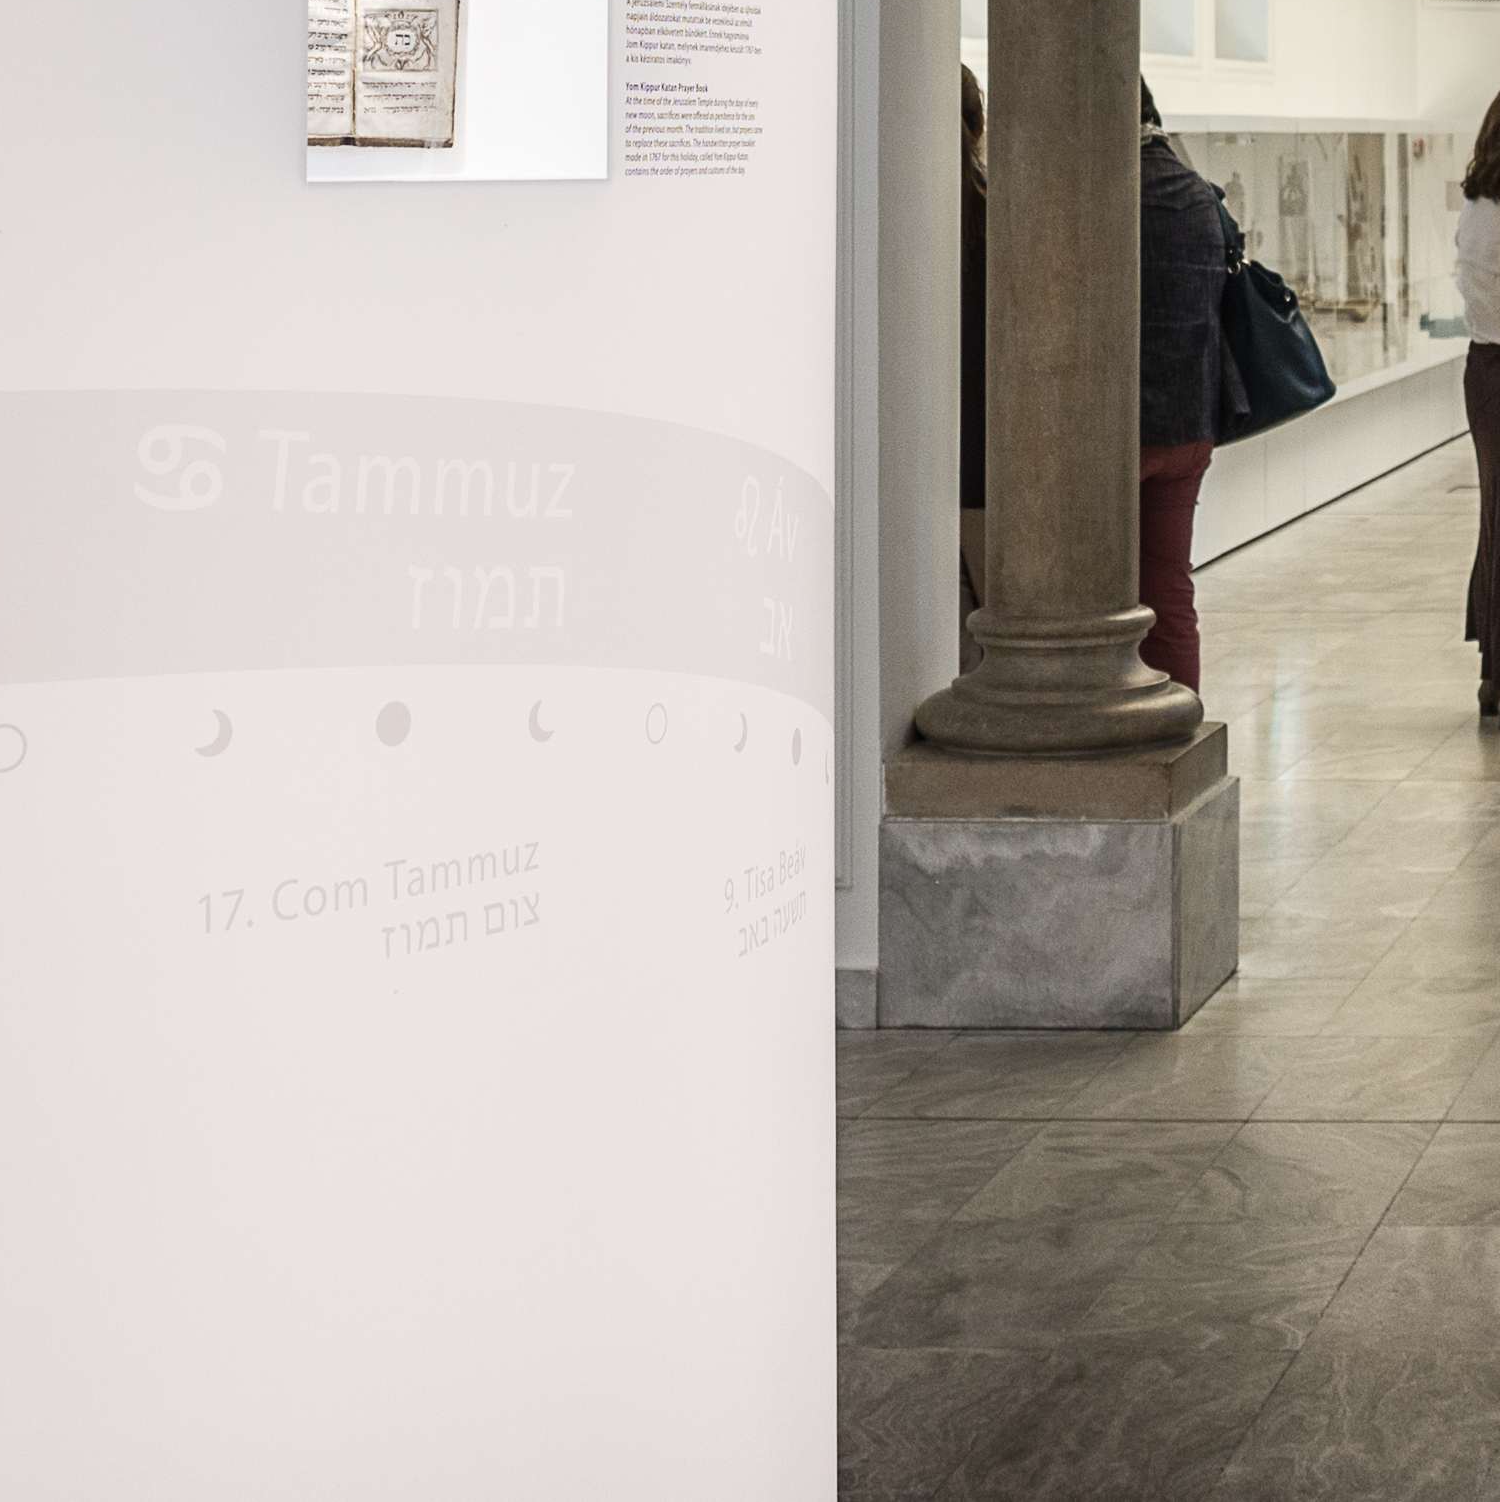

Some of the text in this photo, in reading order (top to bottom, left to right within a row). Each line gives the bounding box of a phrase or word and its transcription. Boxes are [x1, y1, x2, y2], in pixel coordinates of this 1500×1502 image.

[626, 83, 639, 91] Yom
[641, 83, 660, 93] Kippur
[662, 83, 677, 91] Katan
[679, 84, 695, 94] Prayer
[257, 429, 576, 520] Tammuz
[766, 474, 800, 564] Áv
[408, 562, 566, 632] תמוז
[759, 595, 794, 662] אב
[197, 840, 540, 935] 17. Com Tammuz
[723, 840, 807, 916] 9. Tisa Beáv
[380, 888, 540, 961] צום תמוז
[737, 887, 807, 959] תשעה באב
